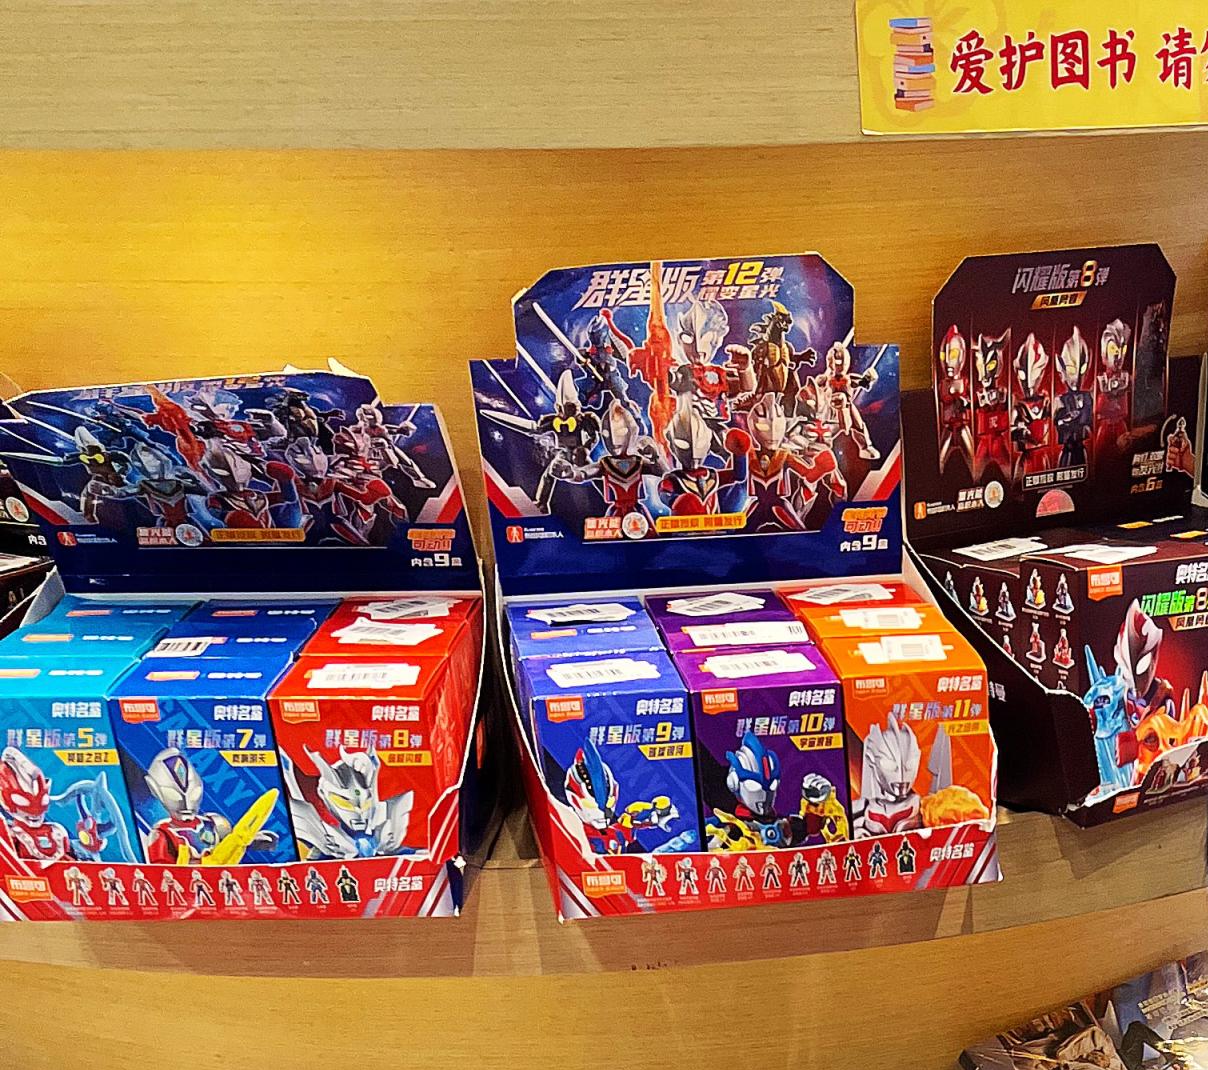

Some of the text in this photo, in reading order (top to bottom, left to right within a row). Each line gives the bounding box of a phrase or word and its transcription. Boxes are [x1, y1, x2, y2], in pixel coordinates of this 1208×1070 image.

[949, 28, 1137, 95] 爱护图书
[701, 261, 785, 287] 第12弹
[1012, 260, 1110, 294] 闪耀版第8弹
[572, 267, 700, 310] 群星版
[892, 699, 983, 722] 群星版第11弹
[589, 722, 686, 747] 群星版第9弹
[736, 712, 837, 738] 群星版第10弹
[7, 728, 108, 750] 群星版第5弹
[167, 728, 268, 750] 群星版第7弹
[325, 728, 423, 750] 群星版第8弹
